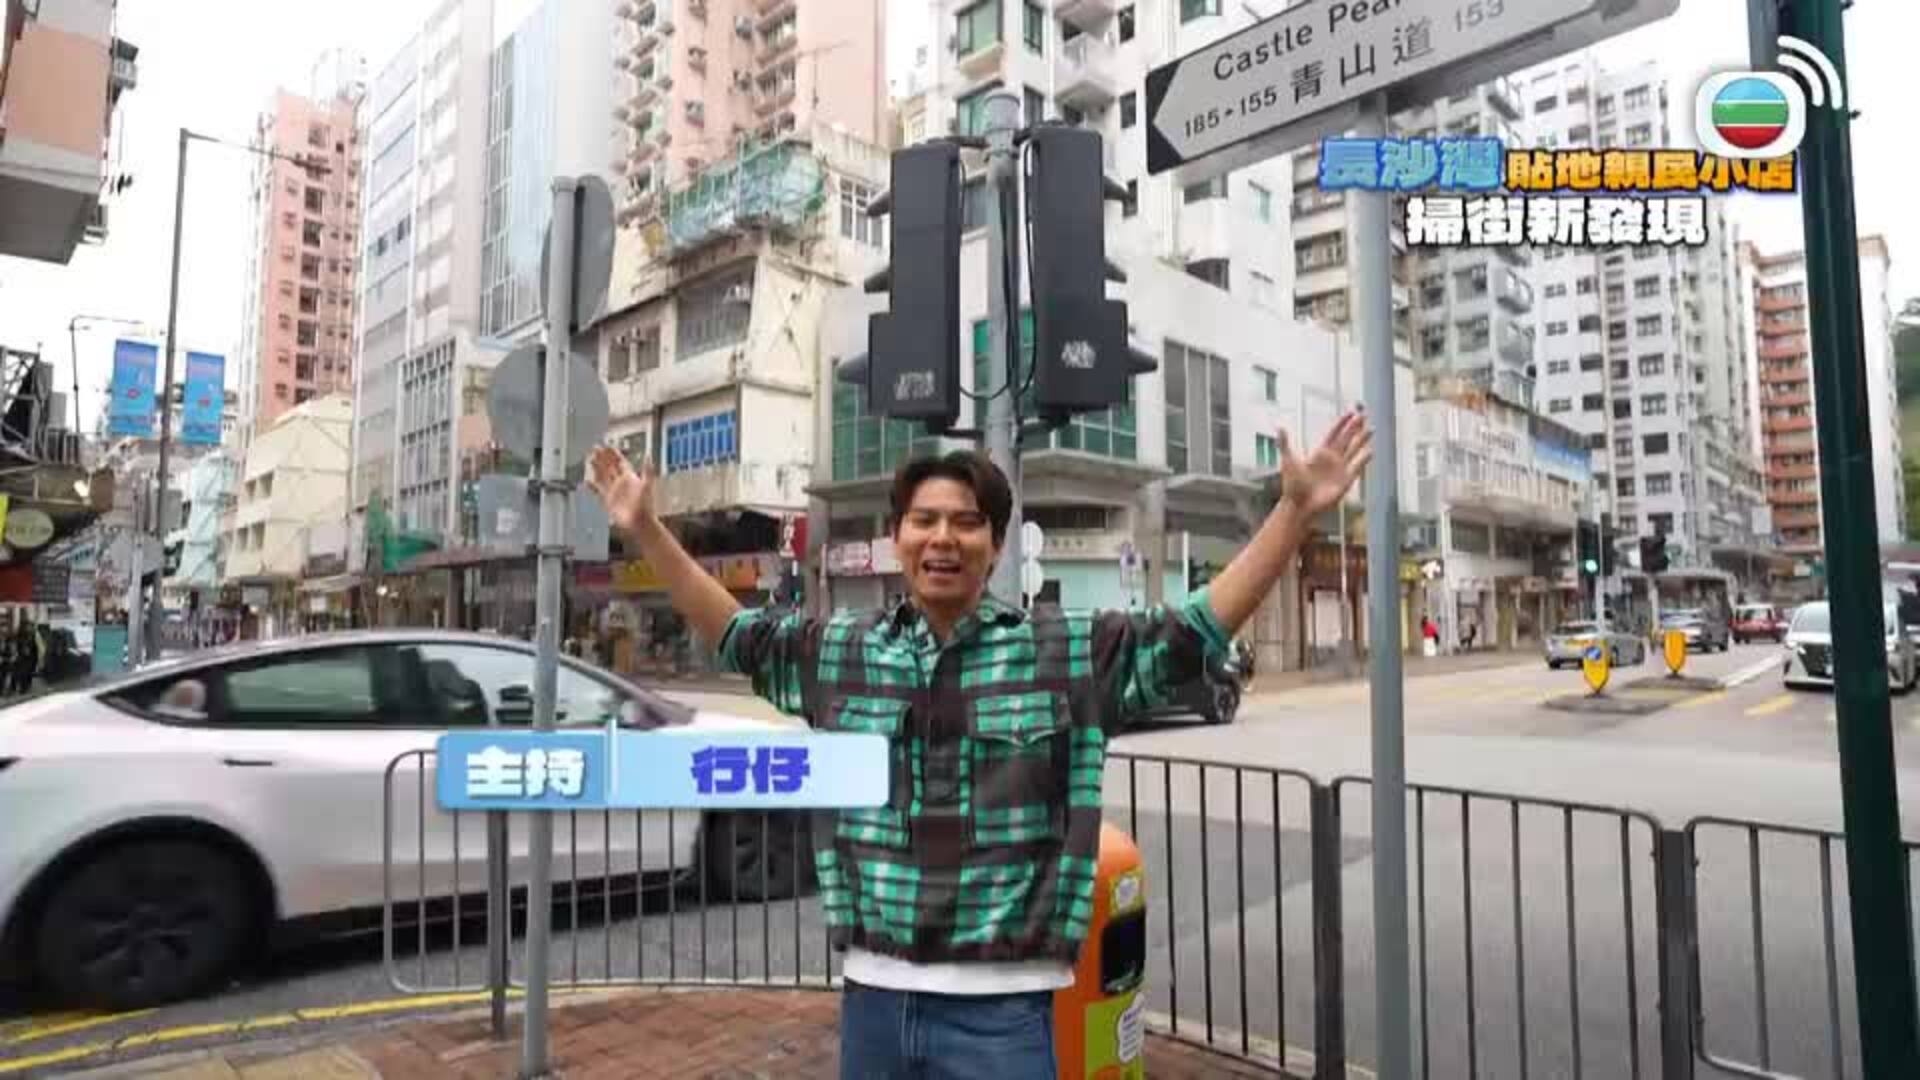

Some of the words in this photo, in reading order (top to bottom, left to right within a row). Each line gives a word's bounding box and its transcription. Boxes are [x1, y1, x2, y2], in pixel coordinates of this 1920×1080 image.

[1213, 24, 1313, 80] Castle
[1290, 16, 1435, 104] 青山道
